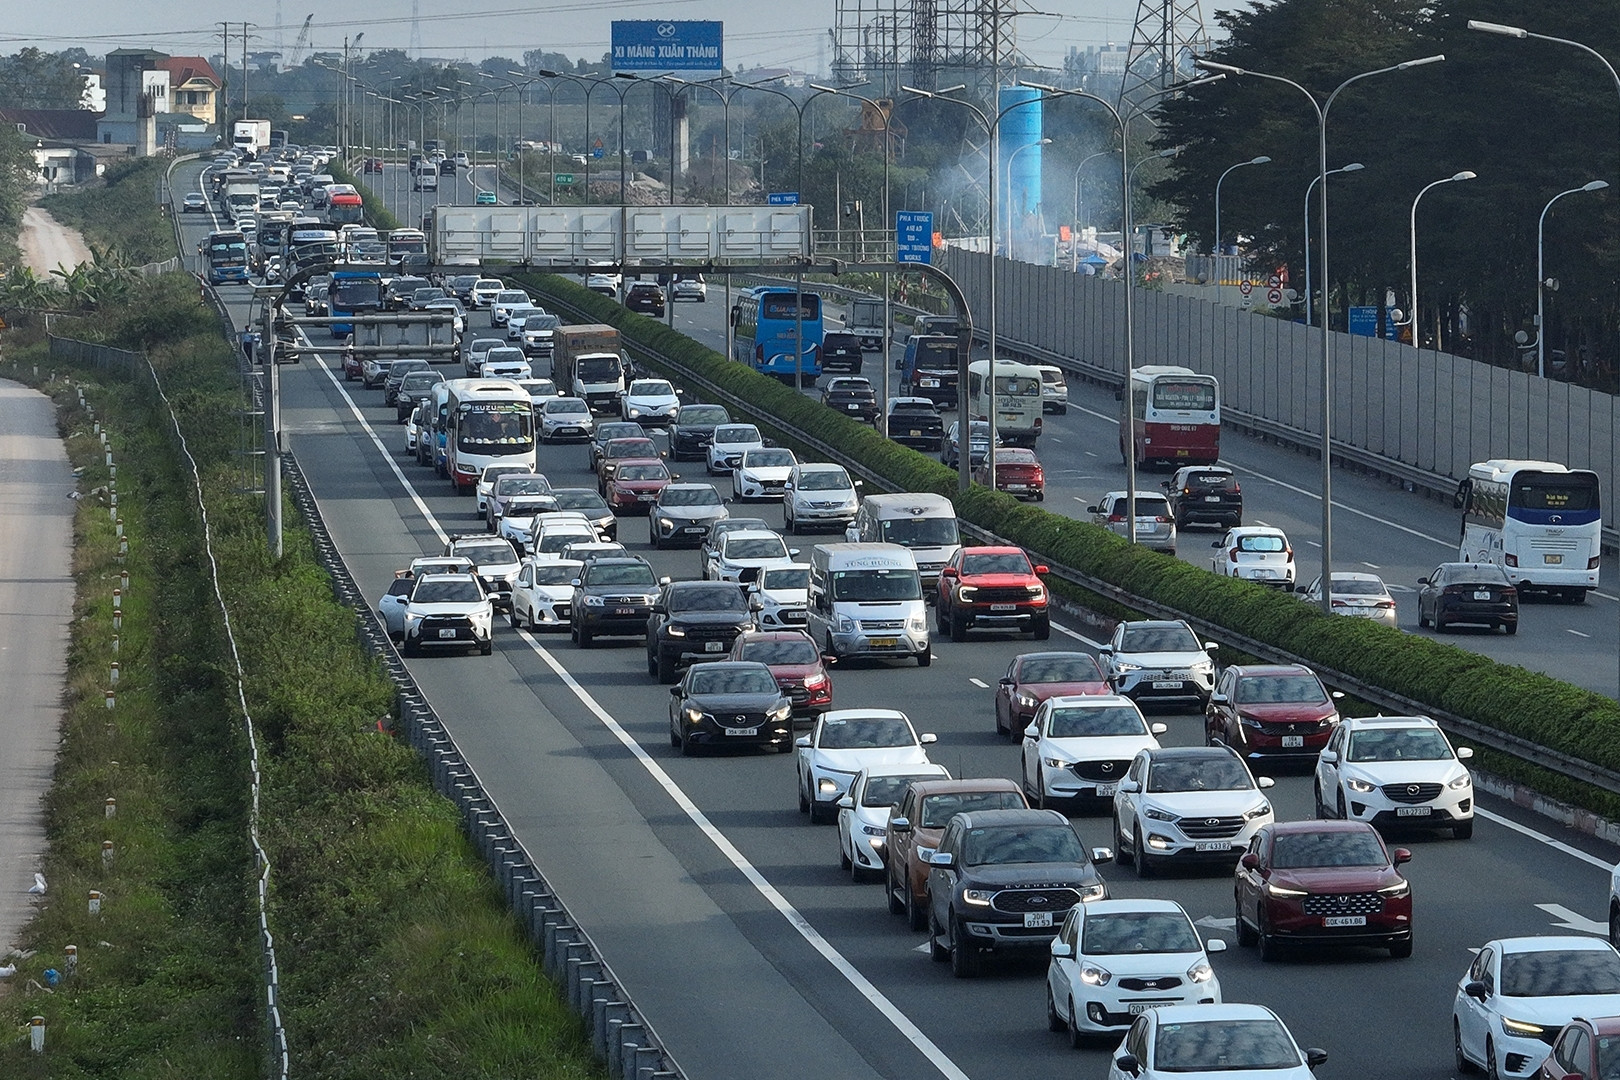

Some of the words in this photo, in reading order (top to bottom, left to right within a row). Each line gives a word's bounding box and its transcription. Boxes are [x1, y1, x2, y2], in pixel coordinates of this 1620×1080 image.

[614, 45, 625, 58] XI
[627, 43, 656, 58] MĂNG
[658, 43, 684, 58] XUÂN
[686, 43, 718, 58] THÀNH
